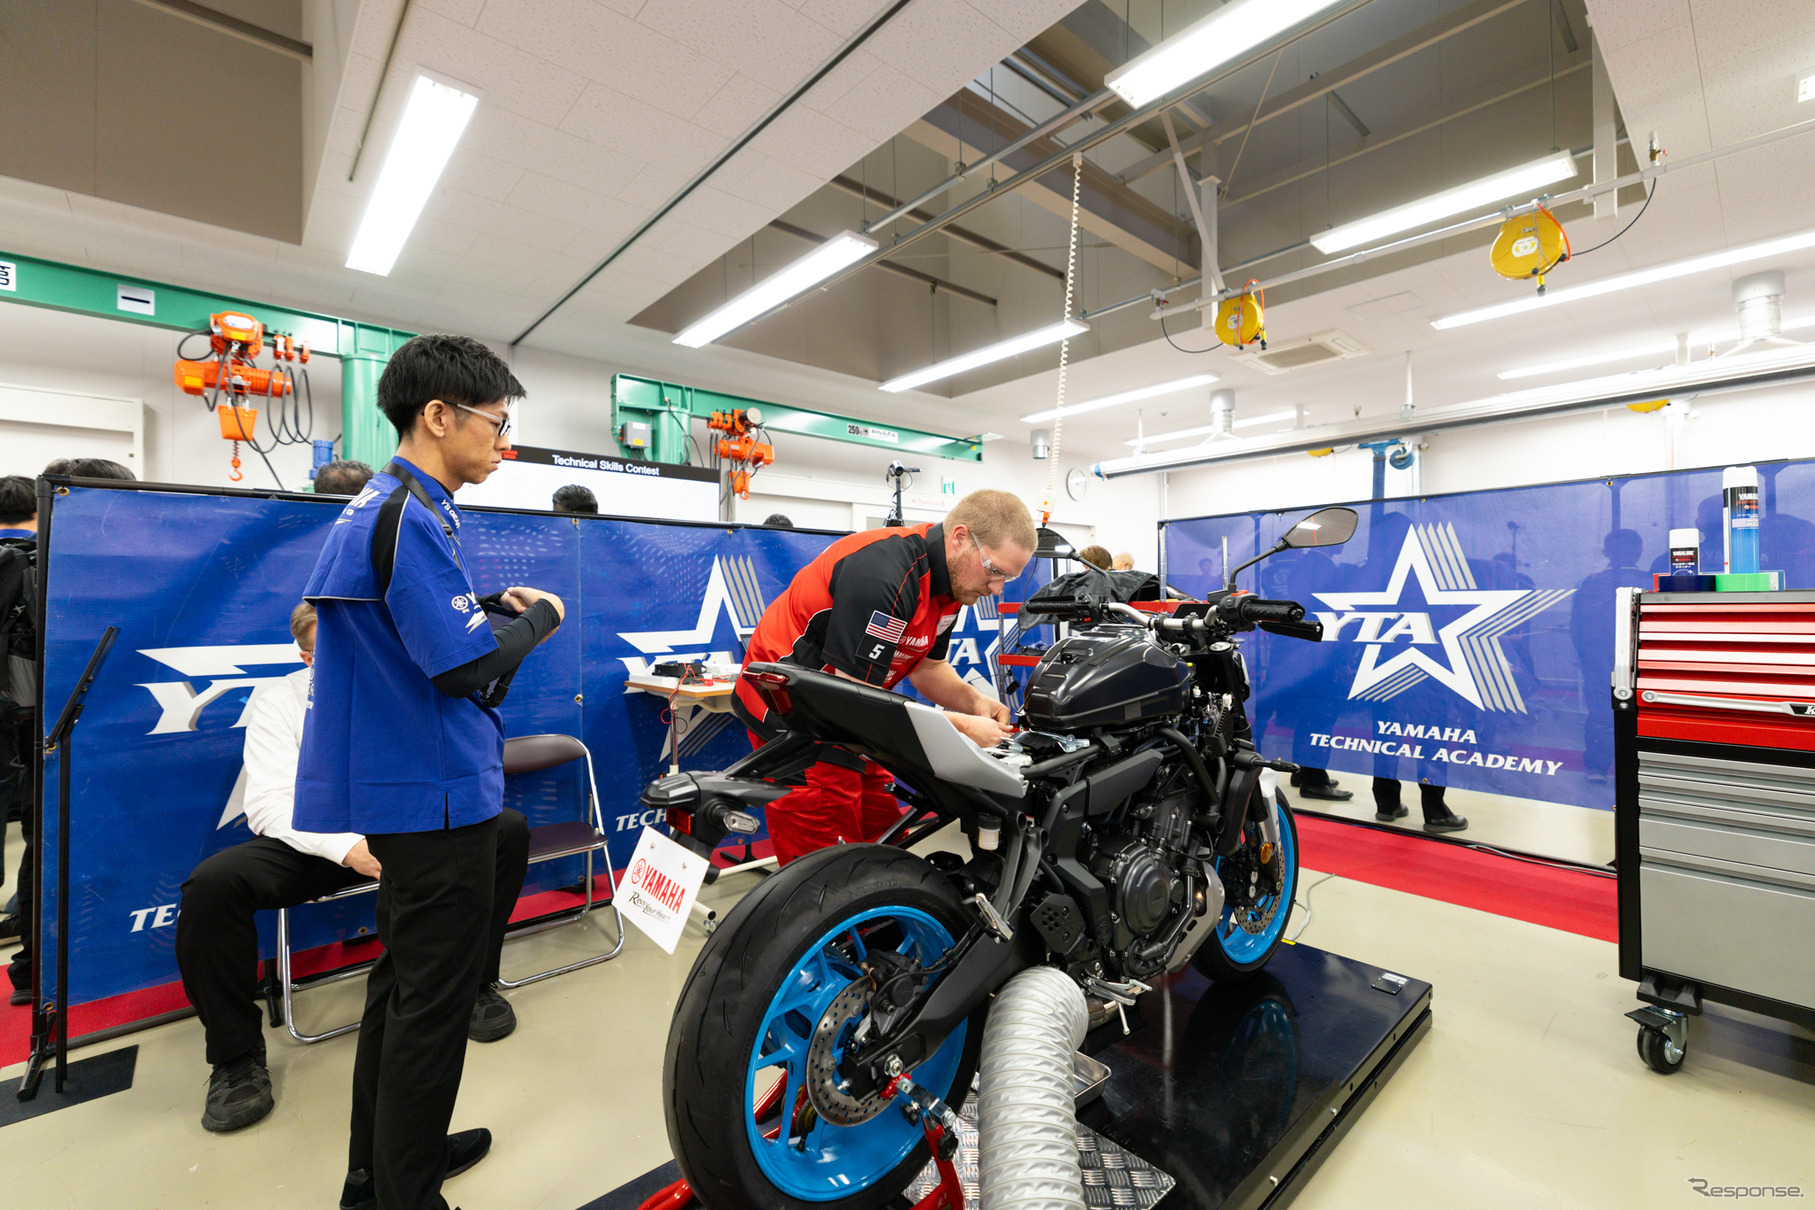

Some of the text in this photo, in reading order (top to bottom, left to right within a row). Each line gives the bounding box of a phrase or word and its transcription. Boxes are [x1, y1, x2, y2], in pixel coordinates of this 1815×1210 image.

[552, 454, 660, 476] Technical Skills Contest
[1311, 611, 1440, 645] YTA
[868, 643, 886, 660] 5
[1377, 720, 1478, 745] YAMAHA
[1309, 733, 1564, 776] TECHNICAL ACADEMY
[641, 864, 686, 915] YAMAHA
